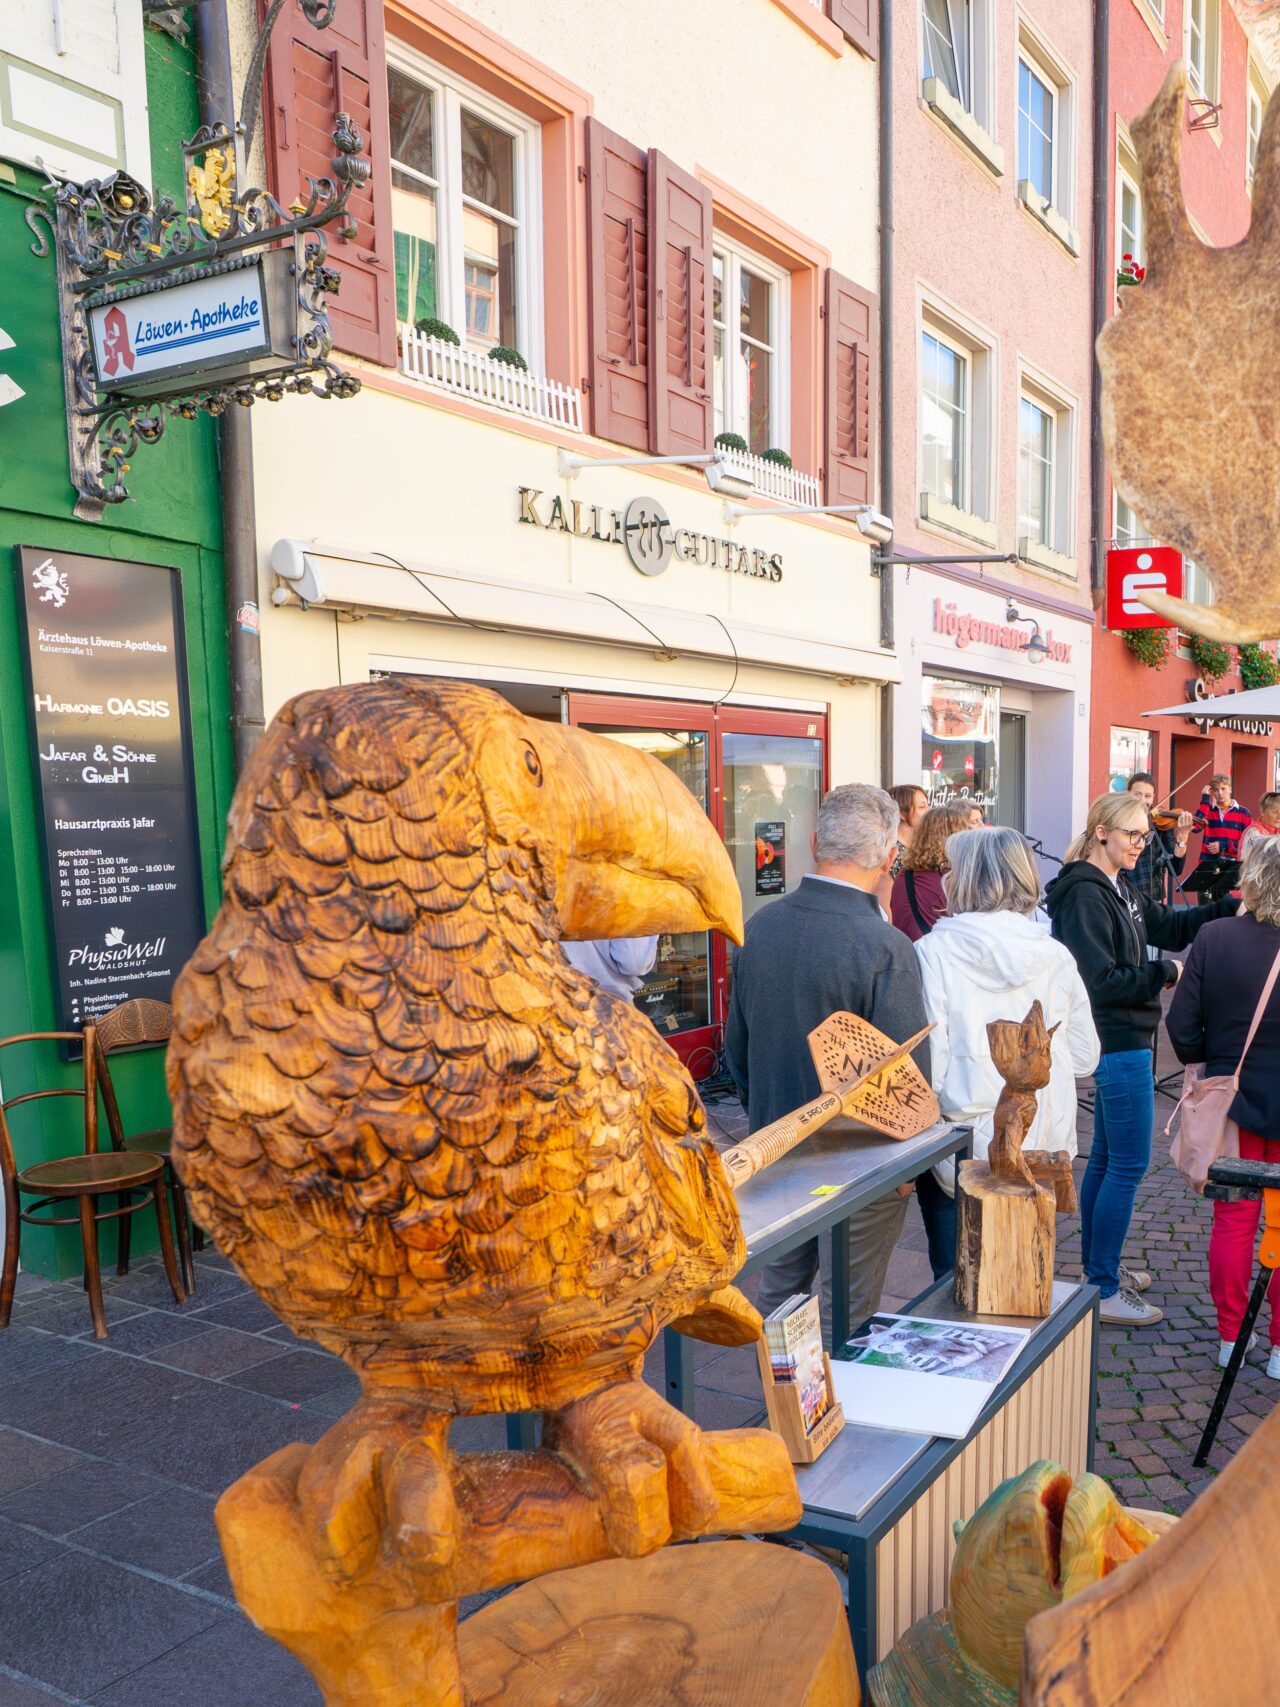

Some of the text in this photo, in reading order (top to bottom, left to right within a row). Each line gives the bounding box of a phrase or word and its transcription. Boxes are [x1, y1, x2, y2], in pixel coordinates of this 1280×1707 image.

[135, 296, 258, 345] Löwen-Apotheke
[675, 528, 783, 583] GUITARS
[38, 629, 168, 653] Ärztehaus Löwen-Apotheke
[40, 643, 93, 656] Kaiserstraße 11
[107, 697, 170, 718] OASIS
[93, 744, 109, 762] &
[55, 817, 155, 831] Hausarztpraxis Jafar
[57, 848, 102, 858] Sprechzeiten
[58, 859, 70, 867] Mo
[73, 858, 89, 866] 8:00
[97, 857, 114, 866] 13:00
[115, 857, 128, 865] Uhr
[59, 869, 68, 877] Di
[74, 868, 90, 876] 8:00
[98, 867, 115, 875] 13:00
[145, 865, 162, 873] 18:00
[163, 864, 175, 872] Uhr
[60, 879, 70, 887] Mi
[75, 878, 90, 886] 8:00
[98, 877, 116, 885] 13:00
[117, 876, 130, 884] Uhr
[61, 889, 71, 897] Do
[76, 888, 91, 896] 8:00
[99, 886, 117, 895] 13:00
[147, 883, 164, 892] 18:00
[62, 899, 70, 907] Fr
[77, 898, 92, 906] 8:00
[100, 896, 117, 904] 13:00
[68, 937, 166, 971] PhysioWell
[99, 959, 147, 971] WALDSHUT
[84, 977, 107, 986] Nadine
[83, 991, 129, 1004] Physiotherapie
[84, 1002, 117, 1013] Prävention
[808, 1098, 836, 1119] PRO GRIP
[852, 1105, 906, 1133] TARGET
[786, 1308, 808, 1328] MICHAEL
